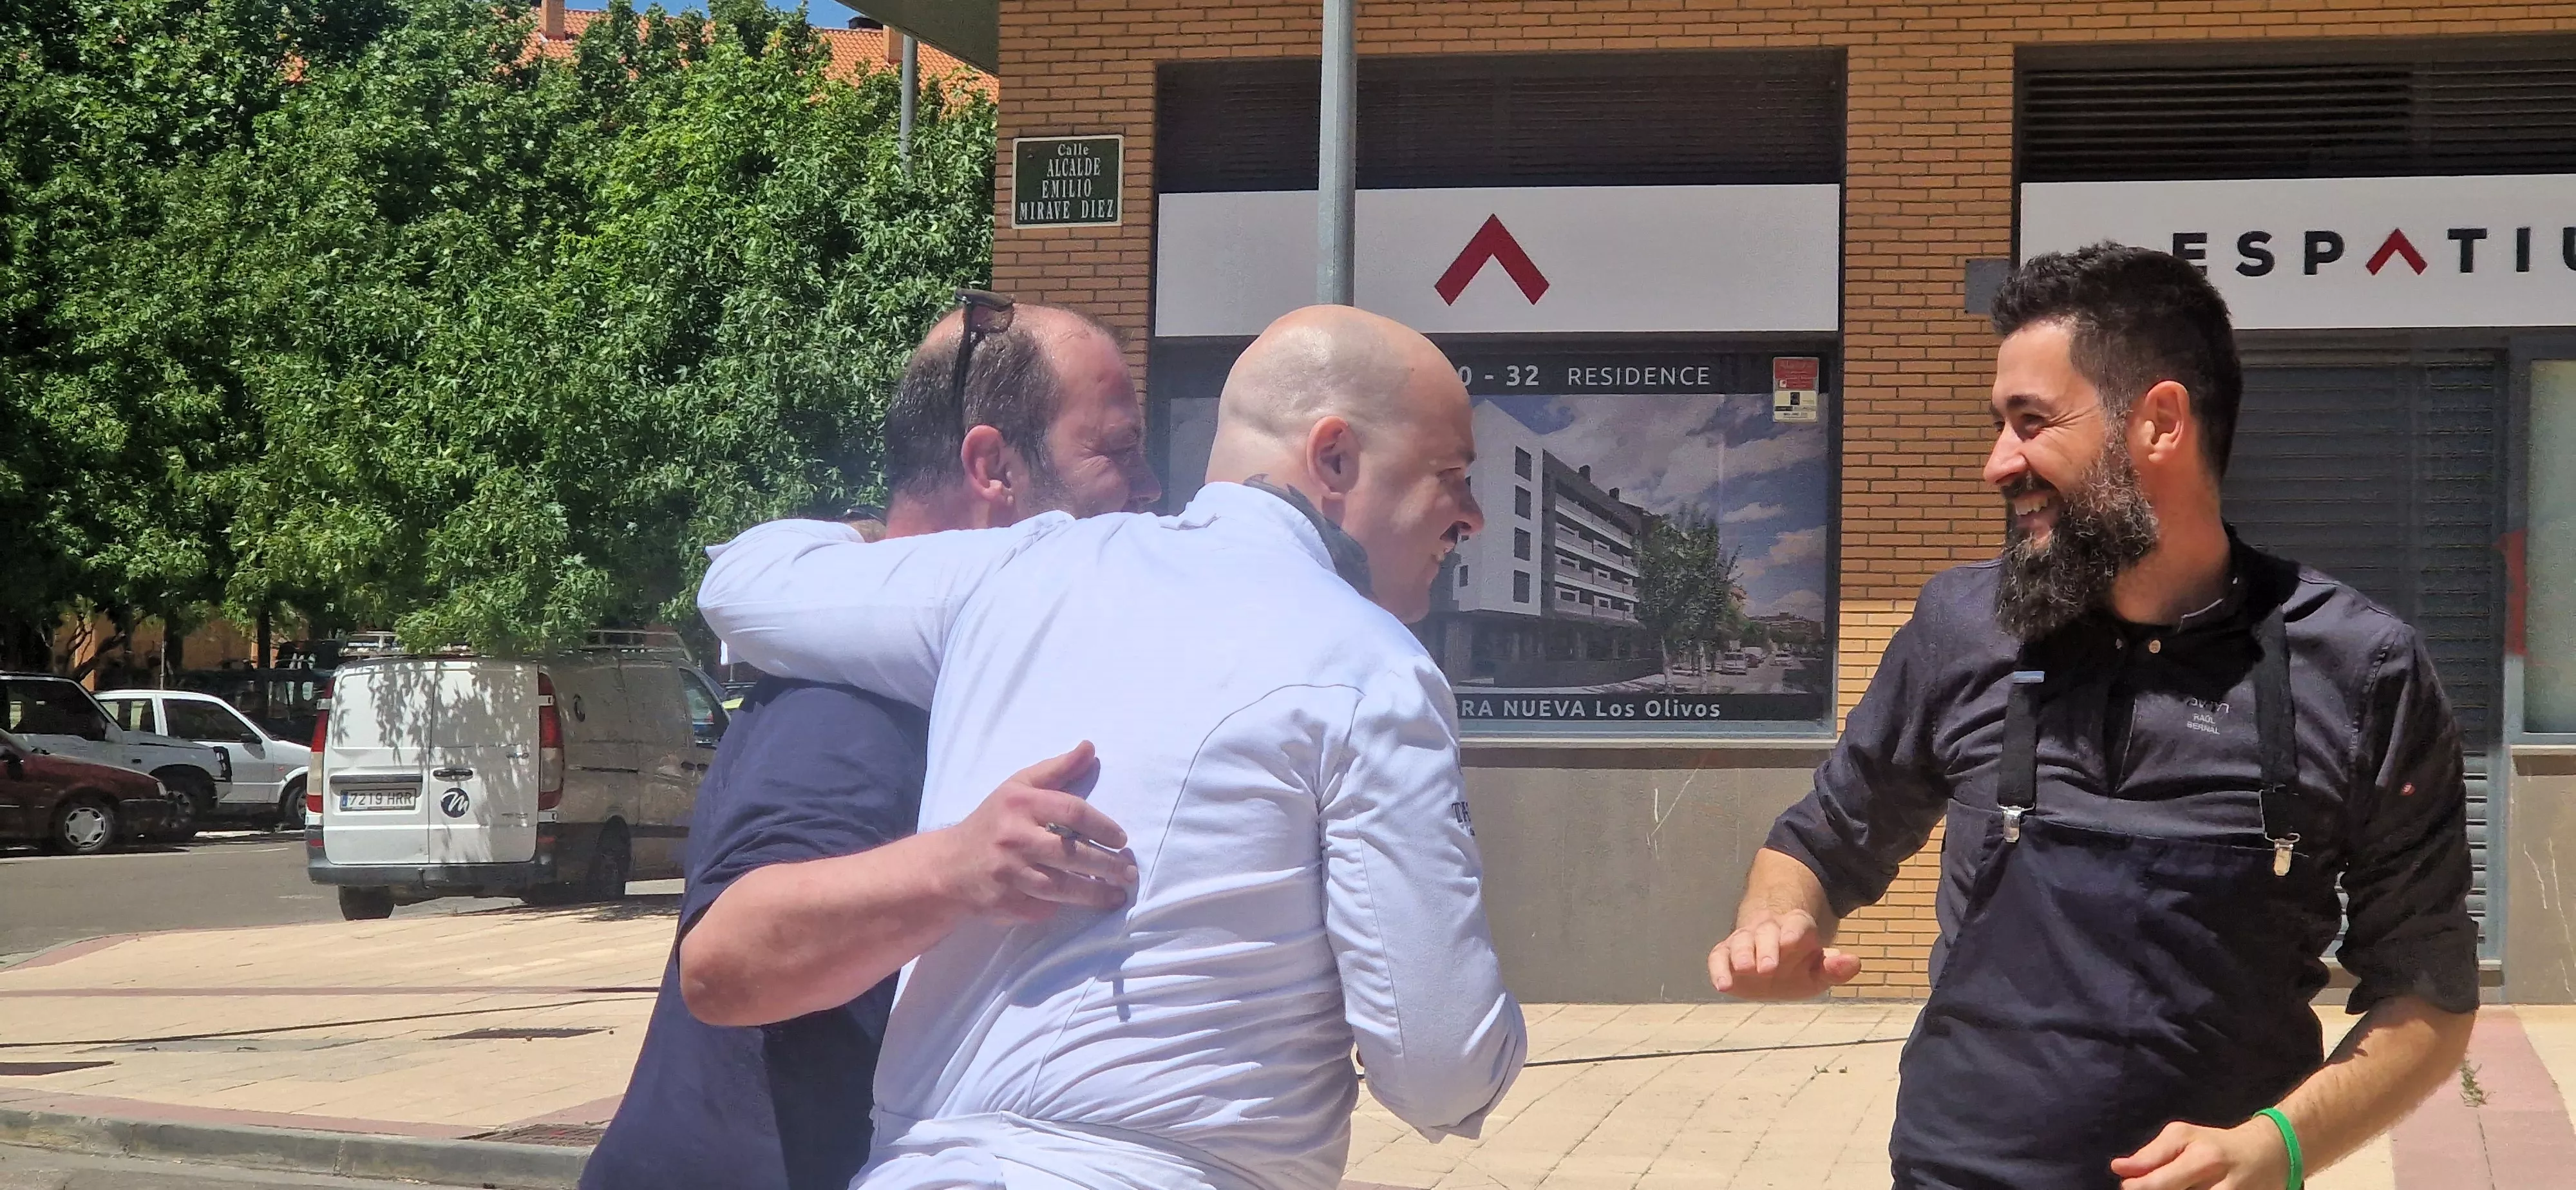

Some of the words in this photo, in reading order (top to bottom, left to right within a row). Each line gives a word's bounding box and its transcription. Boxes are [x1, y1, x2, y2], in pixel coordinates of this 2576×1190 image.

[1057, 142, 1090, 156] Calle
[1046, 157, 1101, 177] ALCALDE
[1041, 178, 1092, 198] EMILIO
[1019, 200, 1070, 220] MIRAVE
[1081, 199, 1113, 218] DIEZ
[1458, 366, 1472, 386] 0
[1506, 365, 1539, 386] 32
[1568, 366, 1710, 386] RESIDENCE
[1461, 699, 1493, 717] RA
[1504, 700, 1586, 717] NUEVA
[1596, 700, 1635, 717] Los
[1645, 699, 1721, 717] Olivos
[2186, 721, 2221, 735] BERNAL
[350, 792, 383, 806] 7219
[387, 792, 412, 805] HRR
